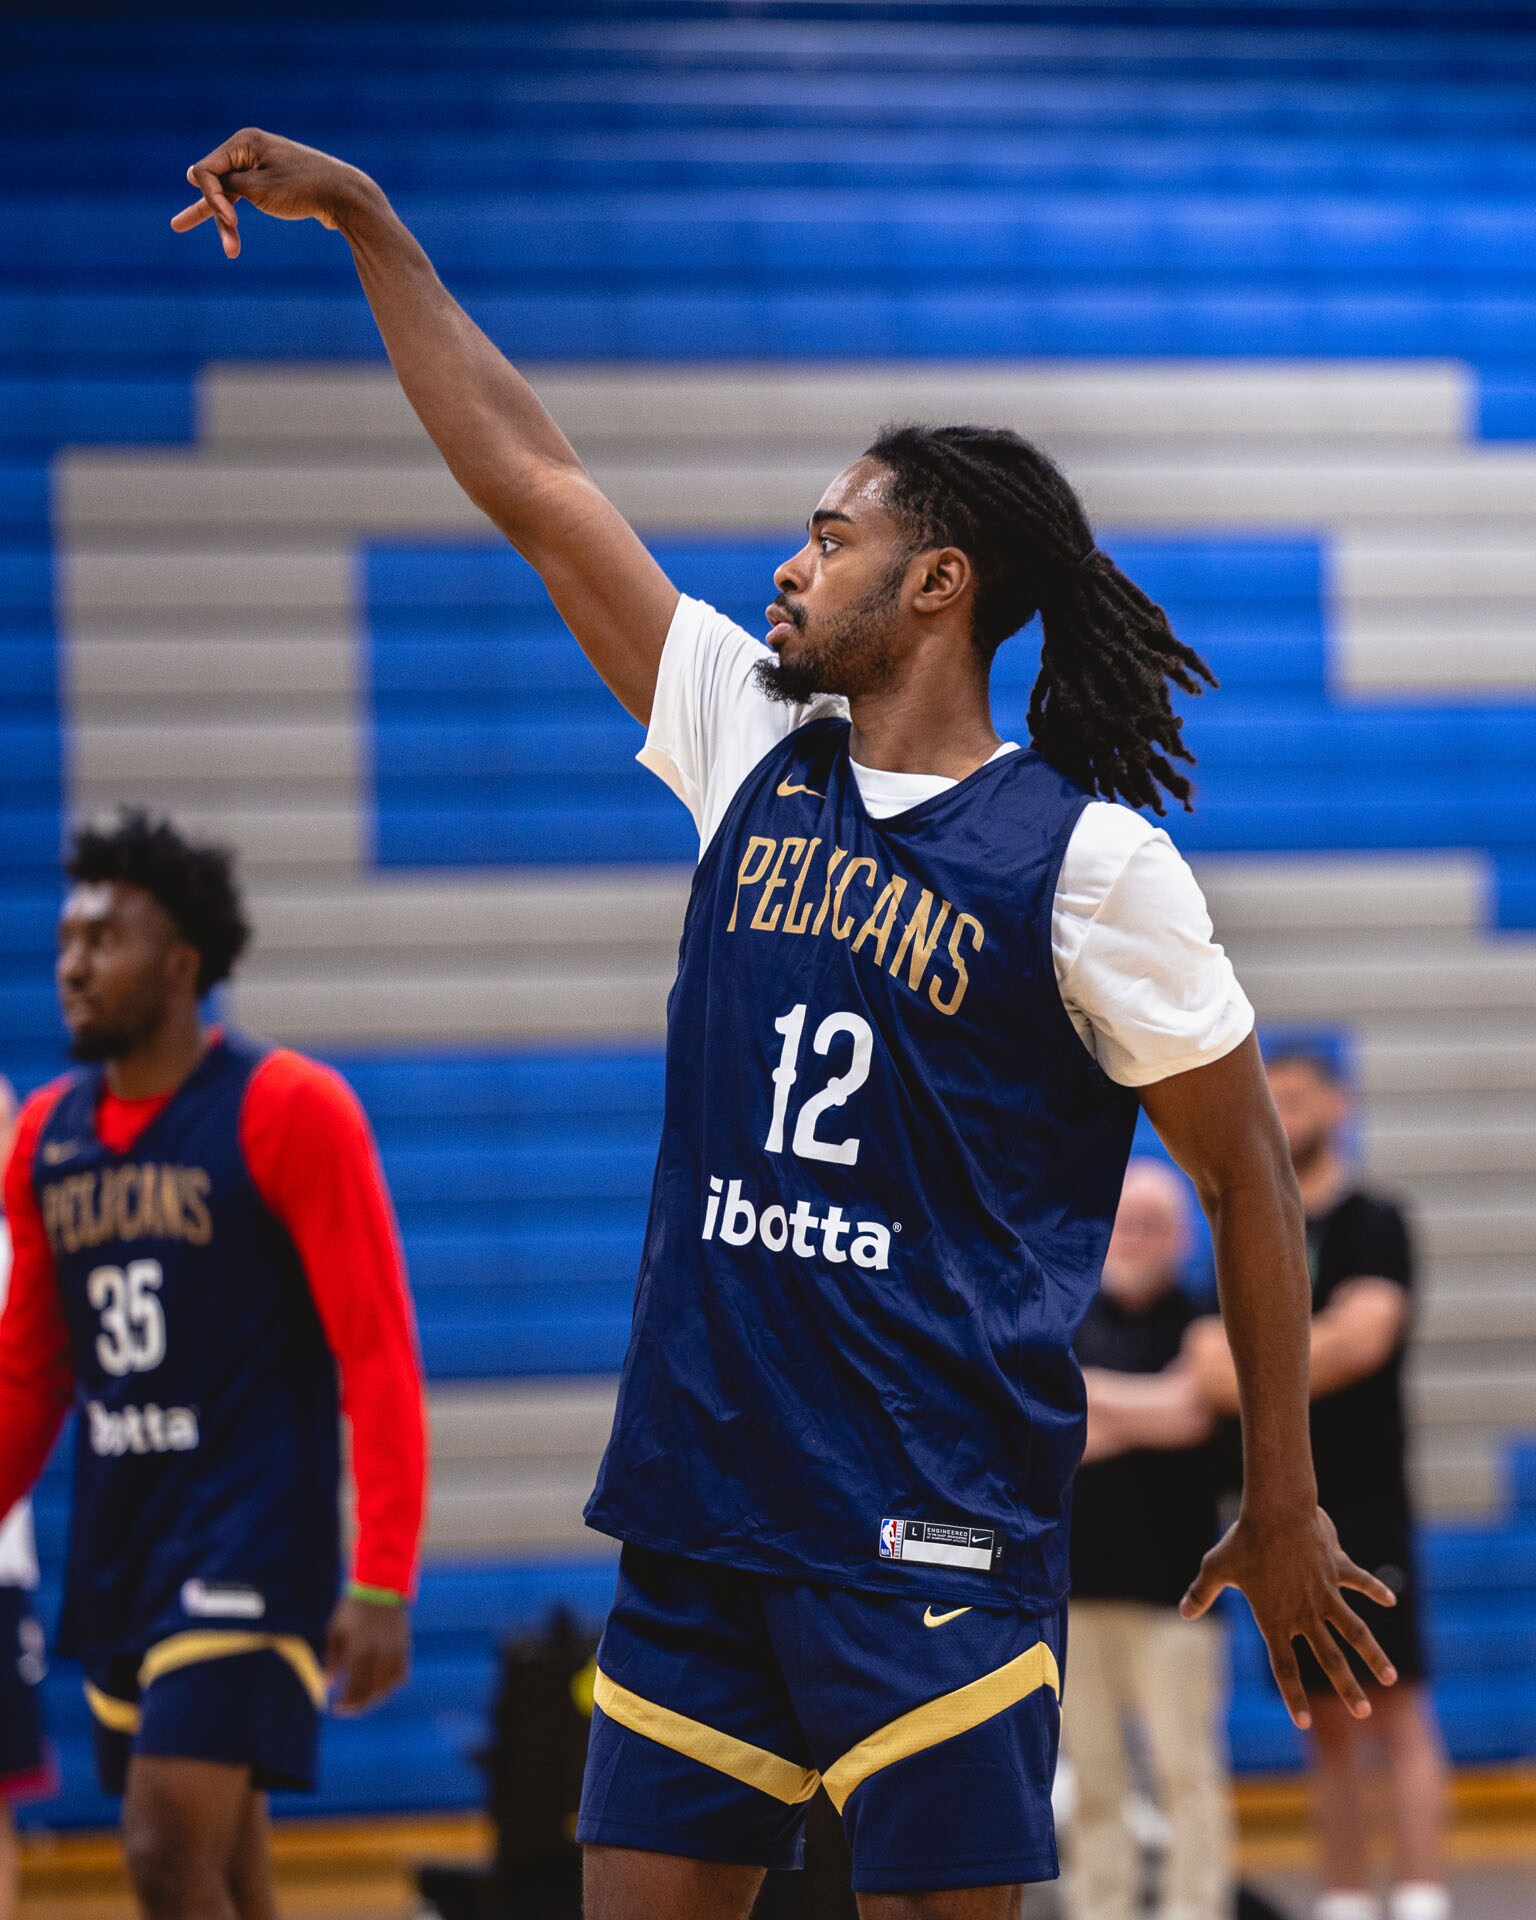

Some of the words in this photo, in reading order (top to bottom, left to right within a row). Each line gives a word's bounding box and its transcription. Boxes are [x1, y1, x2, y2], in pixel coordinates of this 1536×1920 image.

[726, 835, 985, 1016] PELICANS
[764, 1003, 874, 1166] 12
[87, 1258, 167, 1377] 35
[911, 1527, 918, 1536] L
[926, 1527, 968, 1537] ENGINEERED
